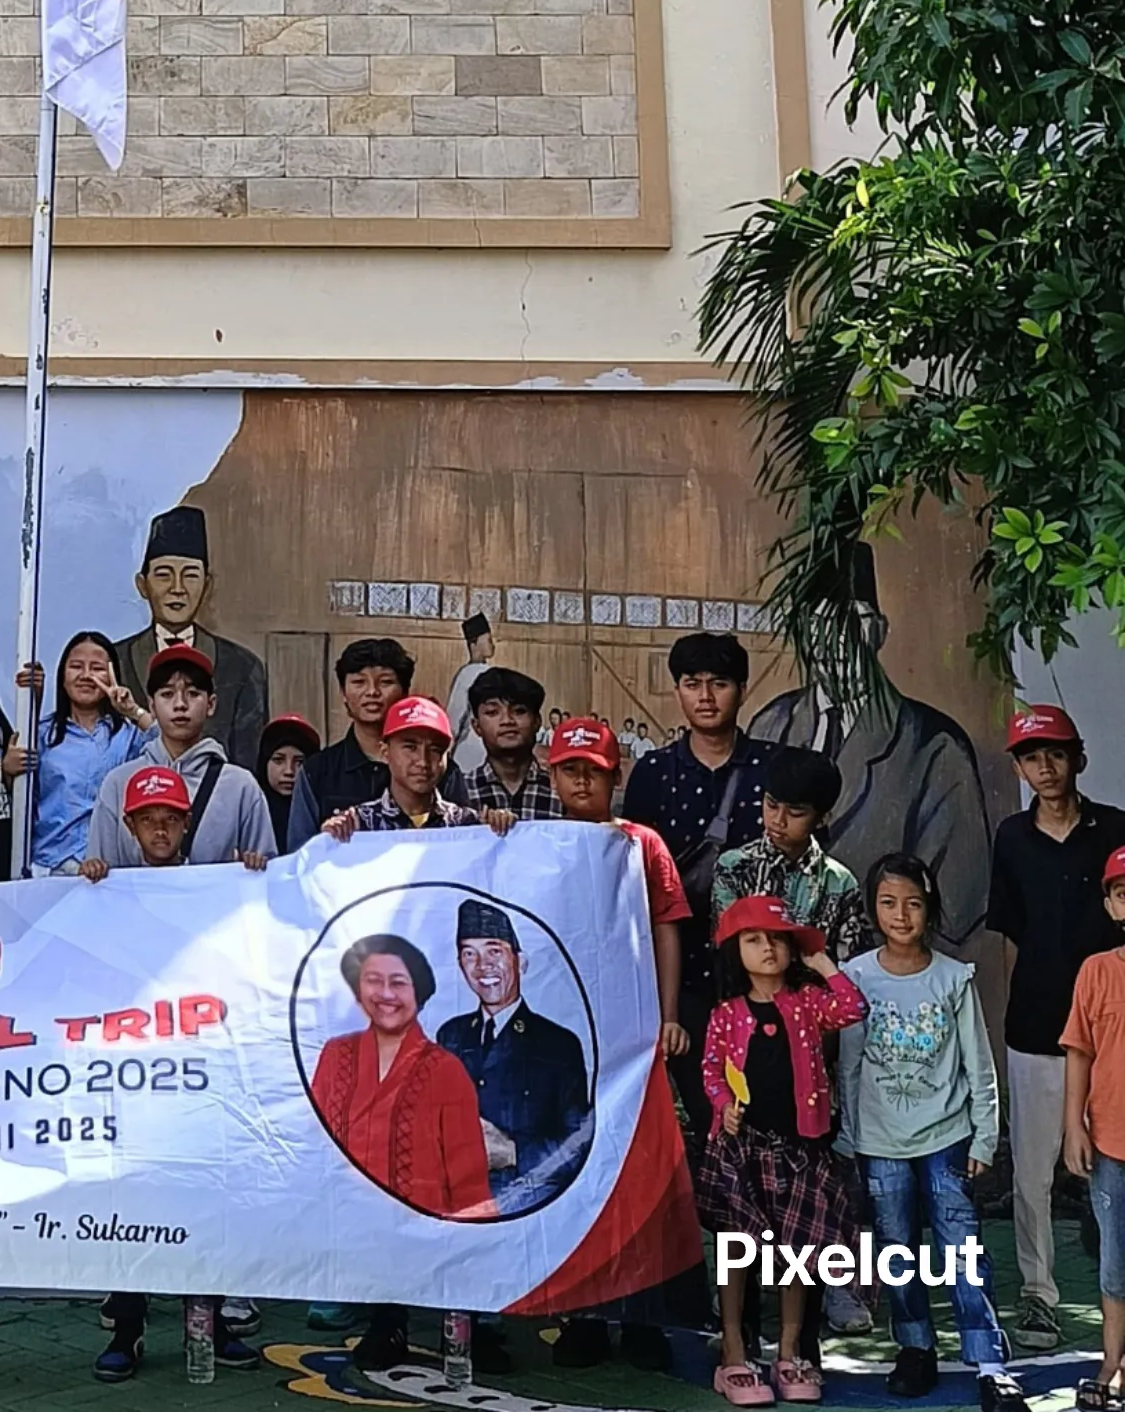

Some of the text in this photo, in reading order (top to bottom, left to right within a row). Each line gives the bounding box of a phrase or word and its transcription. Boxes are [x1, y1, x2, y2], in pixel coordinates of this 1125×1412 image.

[54, 994, 228, 1042] TRIP
[86, 1057, 210, 1092] 2025
[35, 1116, 118, 1144] 2025
[34, 1212, 68, 1240] Ir.
[75, 1213, 191, 1245] Sukarno
